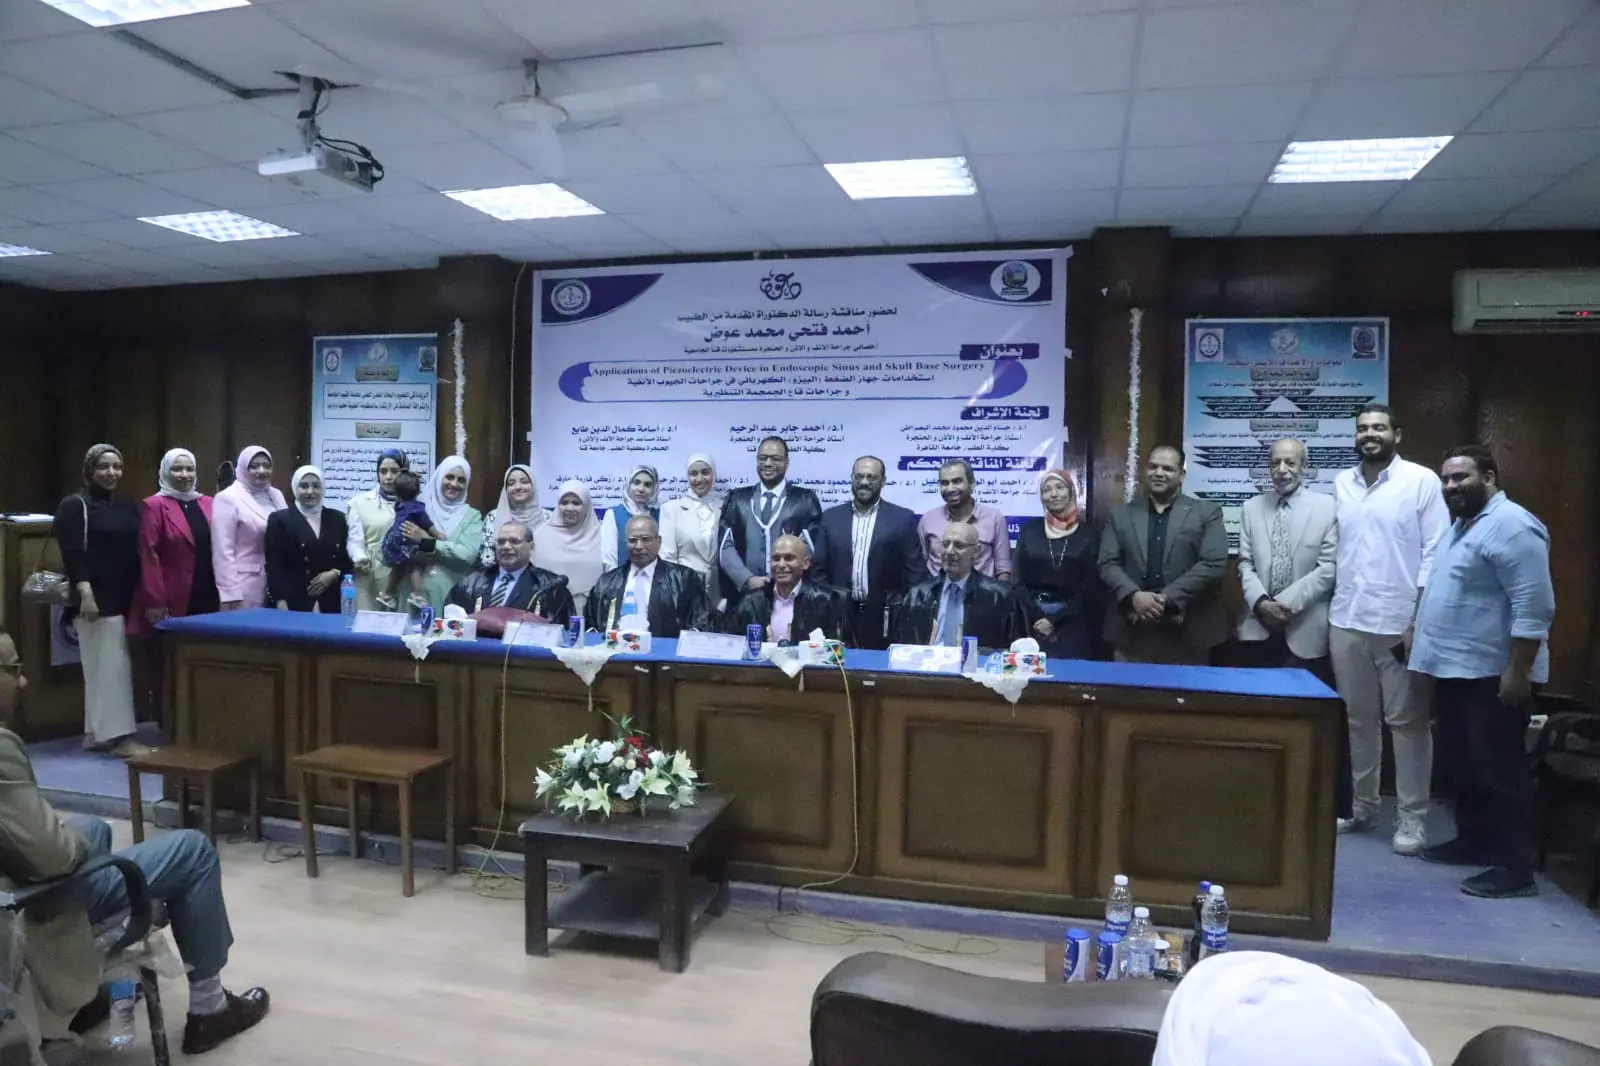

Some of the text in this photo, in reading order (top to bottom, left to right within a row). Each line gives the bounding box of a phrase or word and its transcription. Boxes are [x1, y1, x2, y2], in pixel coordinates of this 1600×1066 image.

[724, 311, 755, 320] المقدمة
[803, 308, 829, 319] رسالة
[831, 306, 865, 317] مناقشة
[867, 306, 898, 318] لحضور
[677, 311, 708, 323] الطبيب
[710, 313, 723, 322] من
[704, 326, 740, 343] عوض
[745, 327, 785, 338] محمد
[980, 343, 1024, 361] بعنوان
[593, 361, 985, 377] Applications of Piezoelectric Device in Endoscopic Sinus and Skull Base Surgery
[656, 378, 687, 387] الجيوب
[688, 376, 723, 386] جراحات
[857, 375, 880, 384] جهاز
[746, 387, 786, 396] الجمجمة
[1014, 407, 1041, 419] لجنة
[590, 425, 610, 435] الدين
[612, 424, 636, 434] كمال
[730, 424, 758, 433] الرحيم
[760, 425, 777, 434] عبد
[780, 424, 799, 434] جابر
[940, 443, 961, 451] جامعة
[967, 443, 984, 451] الطب
[986, 443, 1010, 451] بكلية
